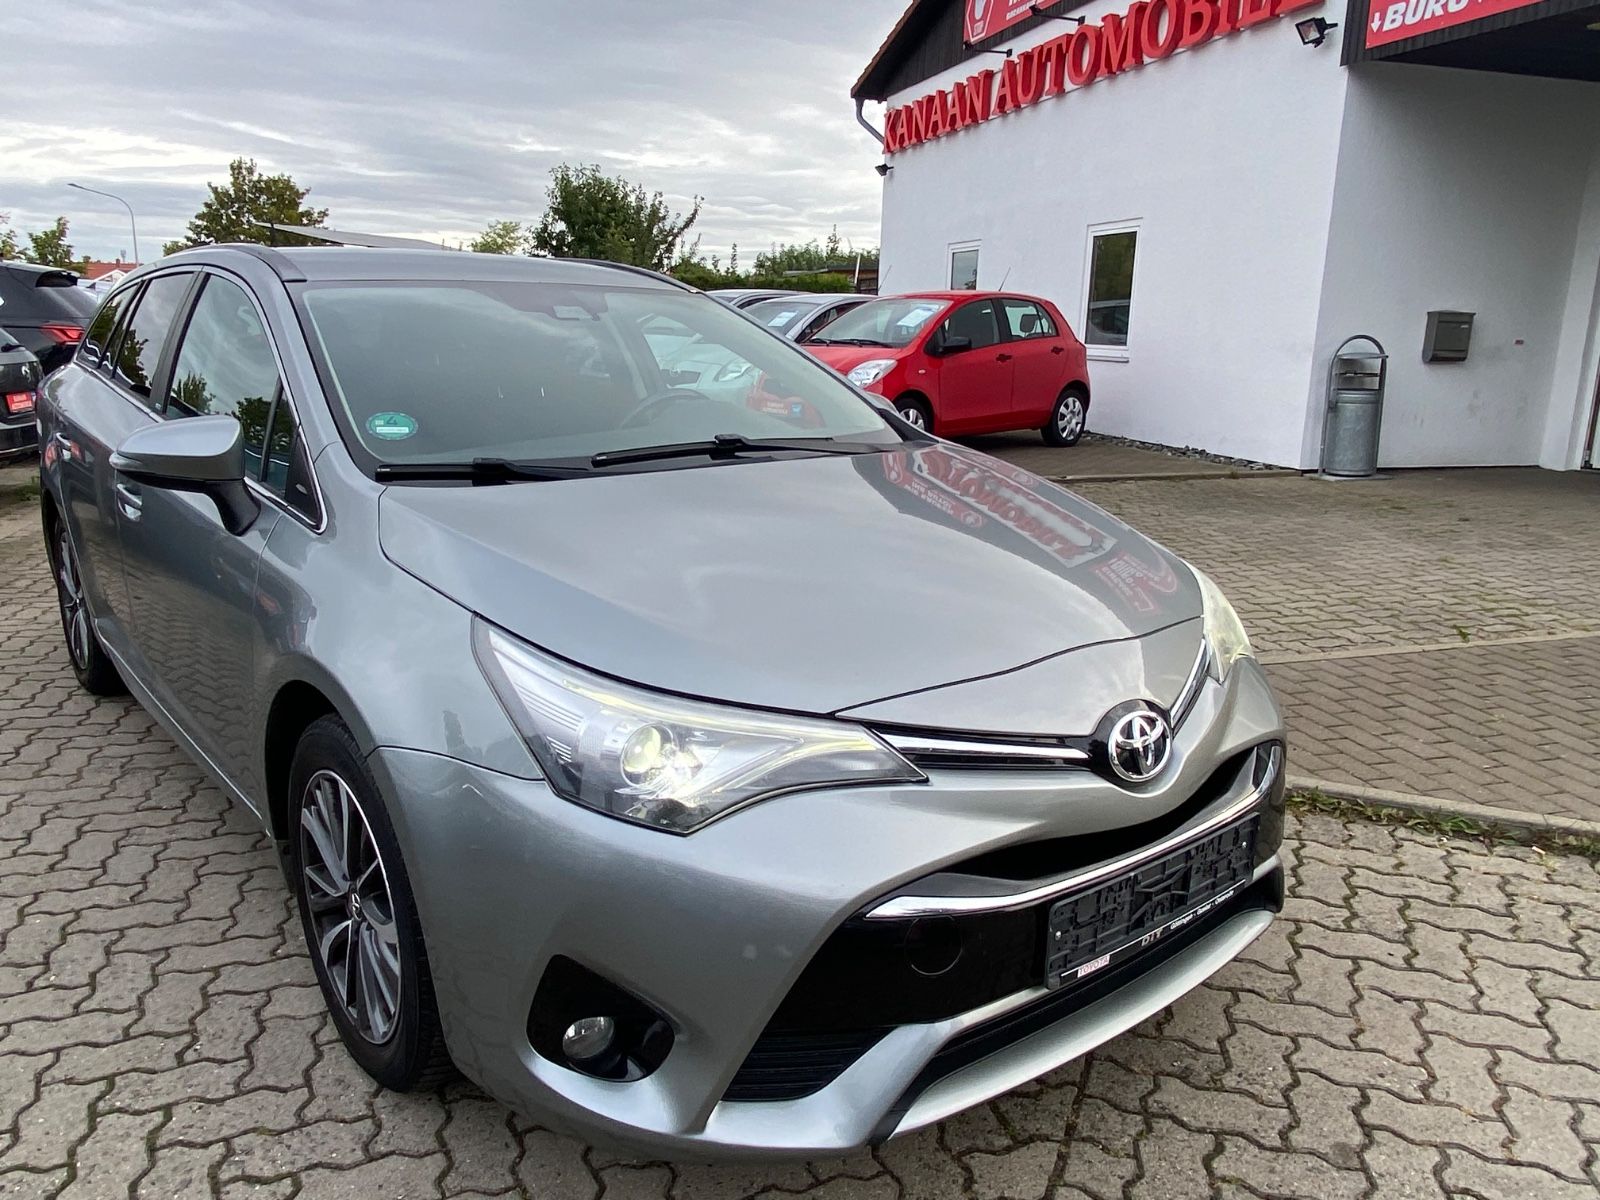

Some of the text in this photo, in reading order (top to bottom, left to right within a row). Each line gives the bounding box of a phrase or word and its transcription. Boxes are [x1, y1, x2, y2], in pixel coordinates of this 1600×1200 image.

[883, 0, 1325, 154] KANAAN AUTOMOBIL
[1078, 954, 1110, 976] TOYOTA
